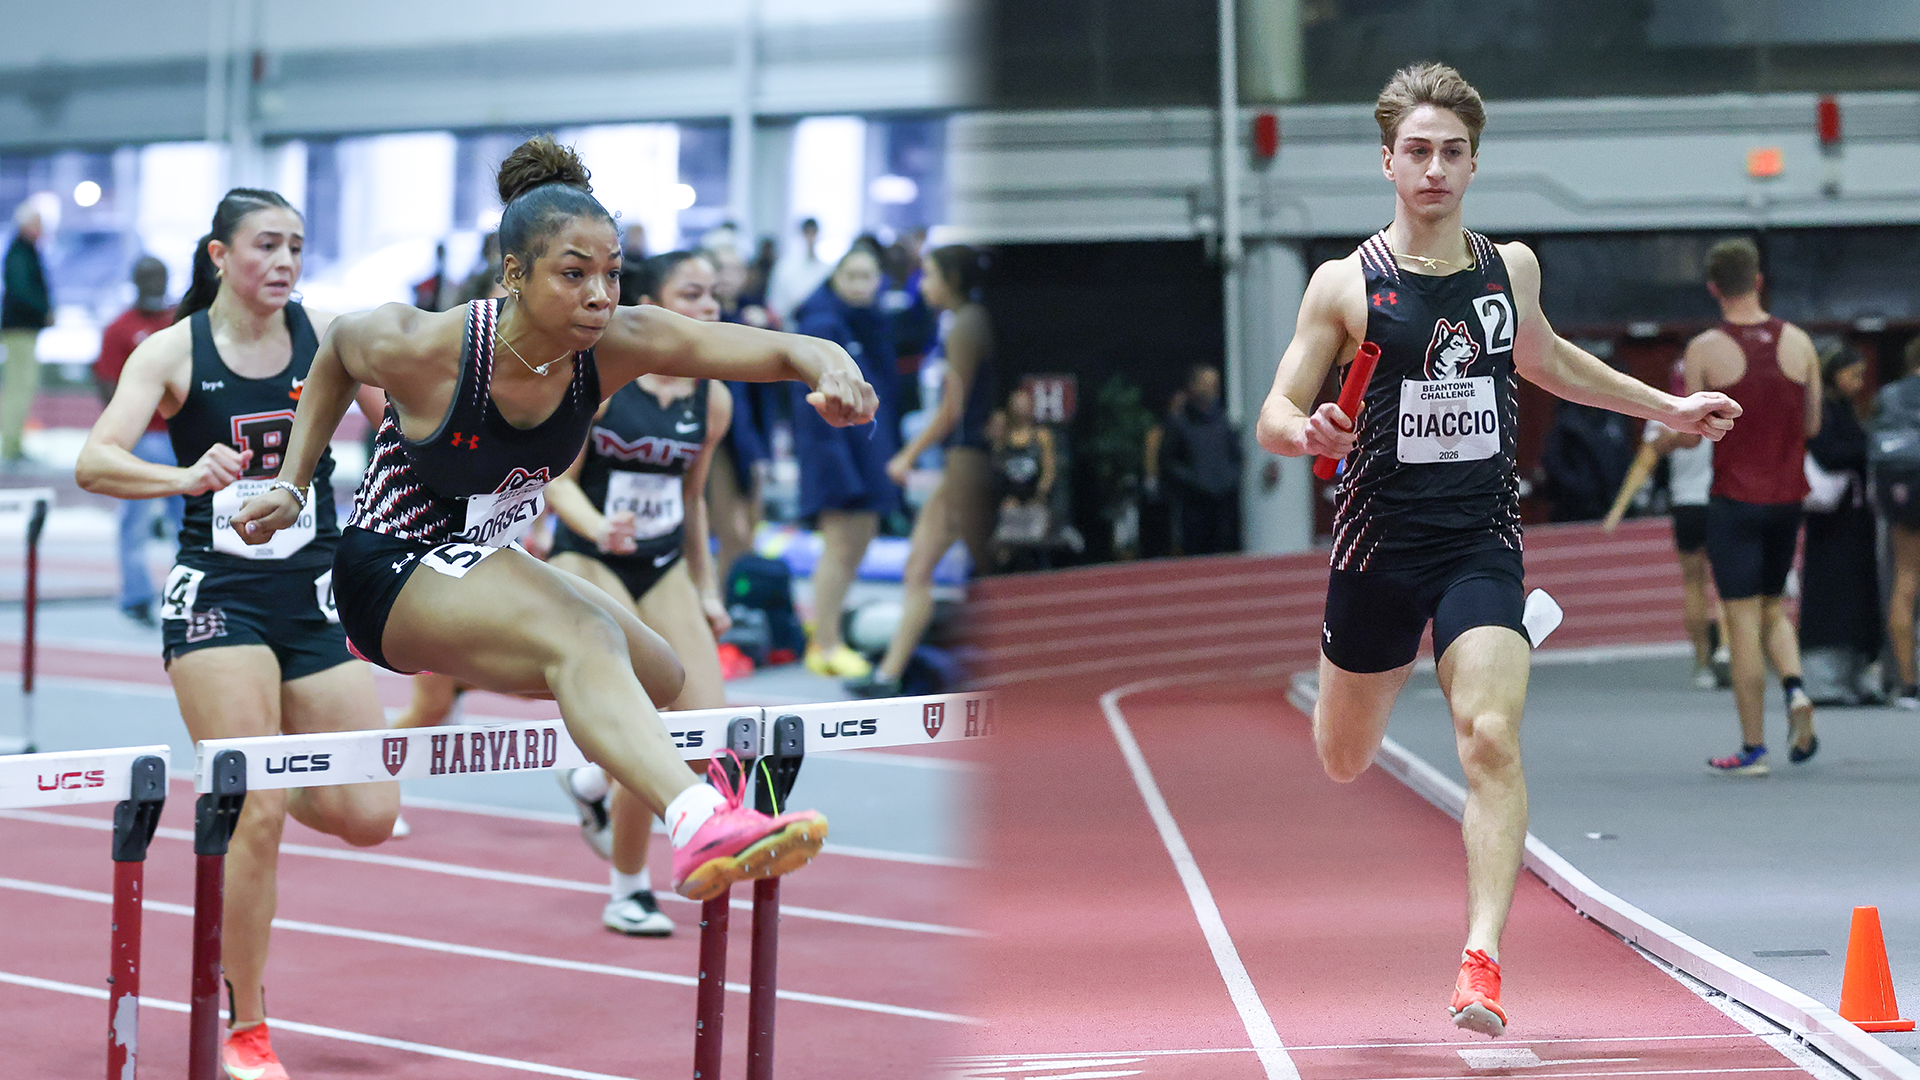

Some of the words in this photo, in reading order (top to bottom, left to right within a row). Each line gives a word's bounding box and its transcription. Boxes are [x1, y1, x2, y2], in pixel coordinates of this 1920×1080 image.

[1482, 299, 1511, 349] 2
[1420, 389, 1476, 400] CHALLENGE
[1422, 382, 1474, 393] BEANTOWN
[1401, 409, 1496, 438] CIACCIO
[231, 409, 295, 480] B
[1439, 451, 1459, 460] 2026
[463, 497, 538, 544] DORSEY
[433, 544, 482, 569] 5
[168, 572, 192, 615] 4
[671, 730, 705, 748] CS
[821, 718, 879, 739] UCS
[430, 728, 557, 775] HARVARD
[266, 754, 331, 774] UCS
[38, 770, 104, 791] UCS
